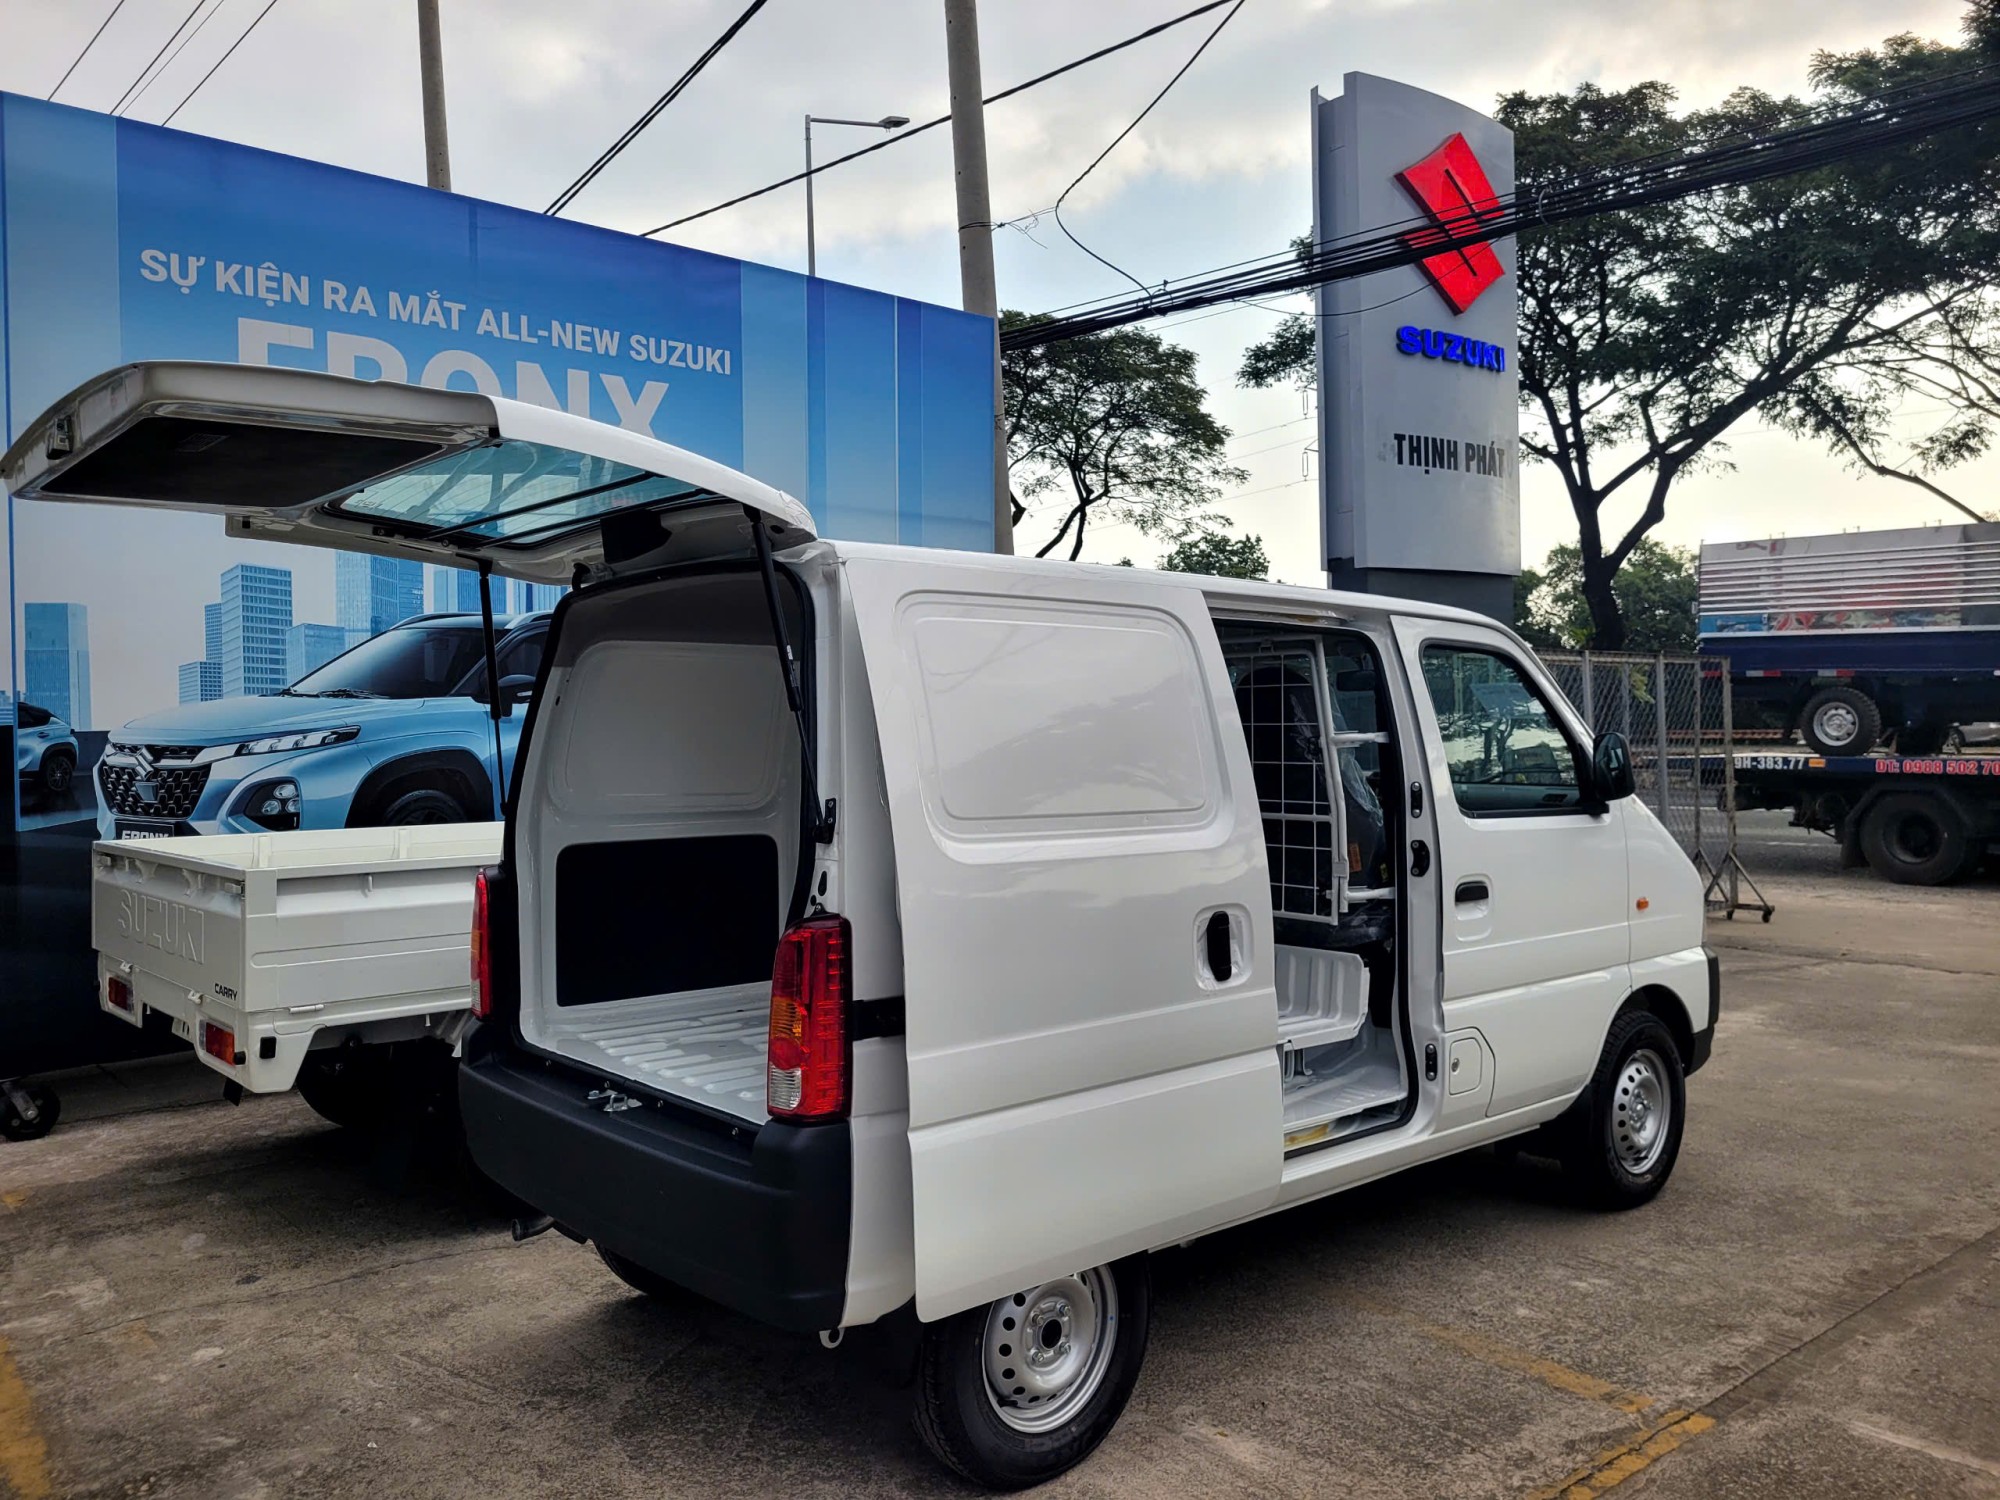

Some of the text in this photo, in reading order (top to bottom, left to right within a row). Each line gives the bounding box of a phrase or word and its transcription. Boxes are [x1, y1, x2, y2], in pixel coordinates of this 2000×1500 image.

[139, 249, 731, 376] SỰ KIỆN RA MẮT ALL-NEW SUZUKI
[1396, 326, 1505, 372] SUZUKI
[1394, 433, 1505, 478] THỊNH PHÁT
[1903, 760, 1943, 774] 0988
[1946, 760, 1978, 775] 502
[1981, 761, 2000, 775] 70
[118, 889, 205, 965] SUZUKI
[214, 983, 238, 1001] CARRY
